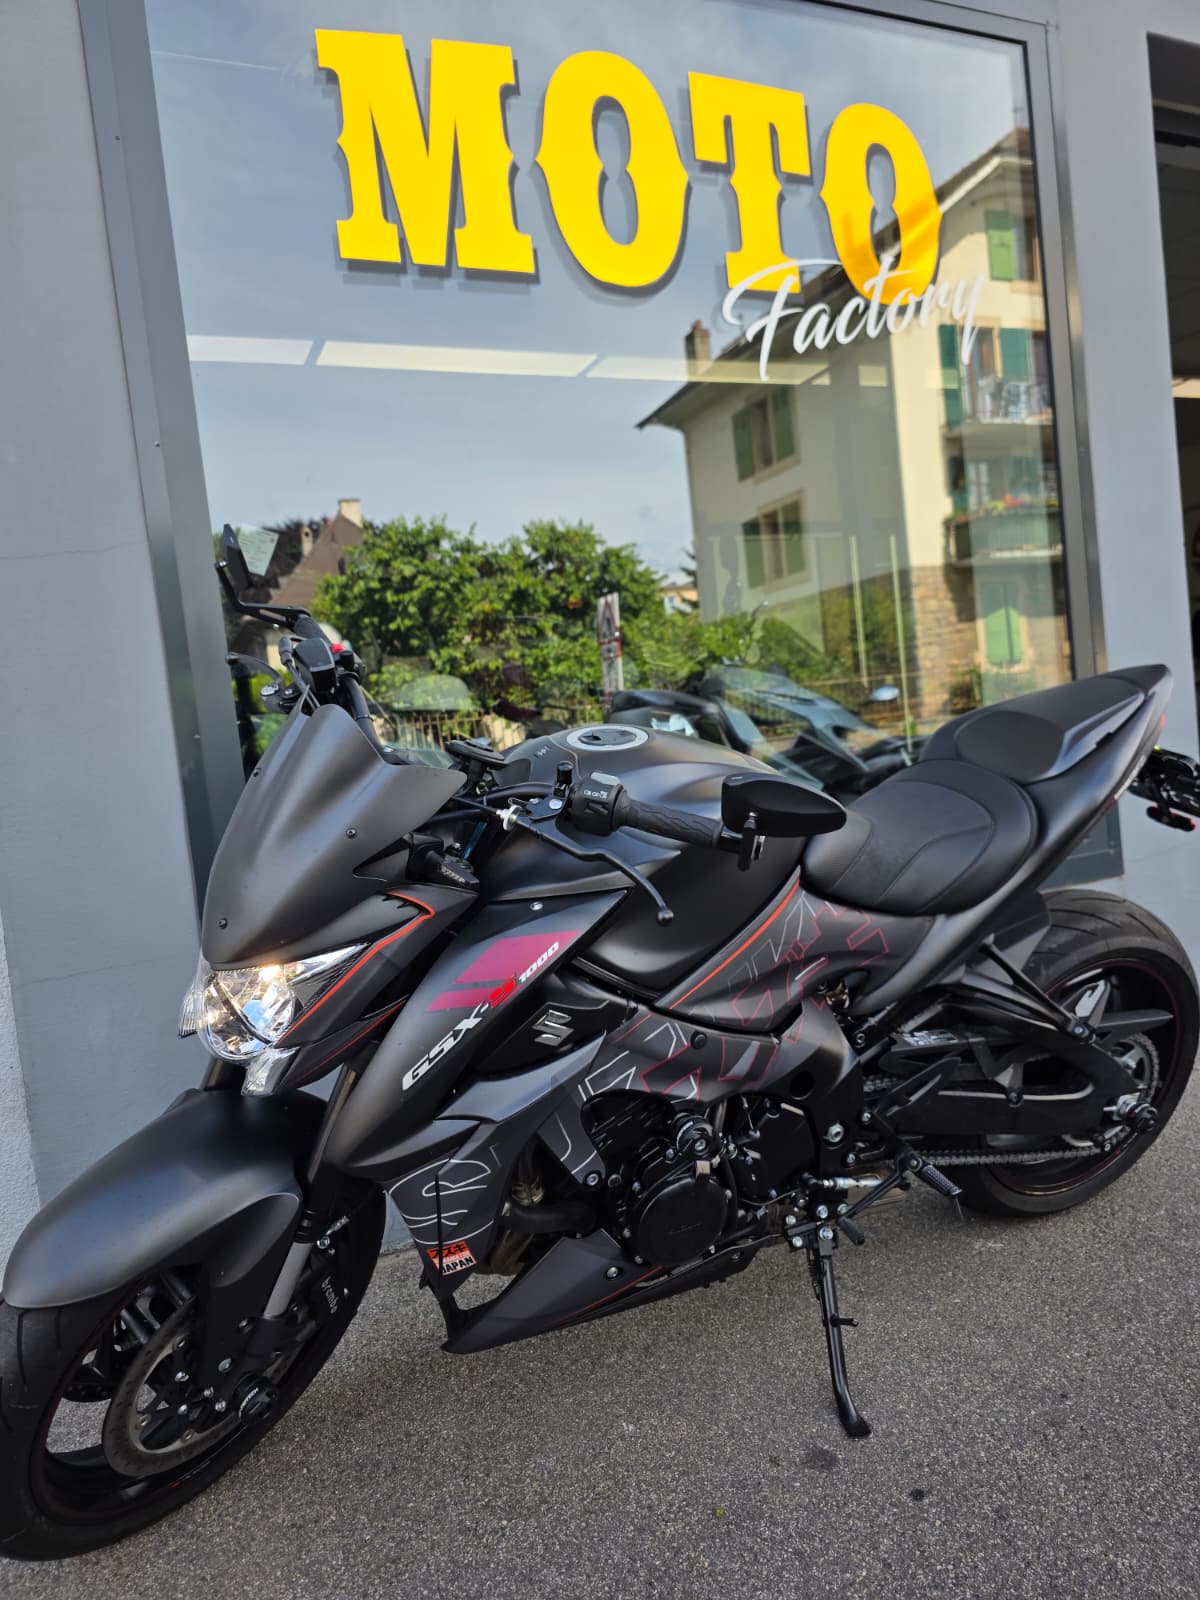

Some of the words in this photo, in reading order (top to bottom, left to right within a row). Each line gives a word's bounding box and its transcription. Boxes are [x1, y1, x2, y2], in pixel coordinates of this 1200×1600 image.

[315, 29, 943, 305] MOTO
[722, 256, 984, 382] Factory
[442, 1256, 474, 1273] JAPAN
